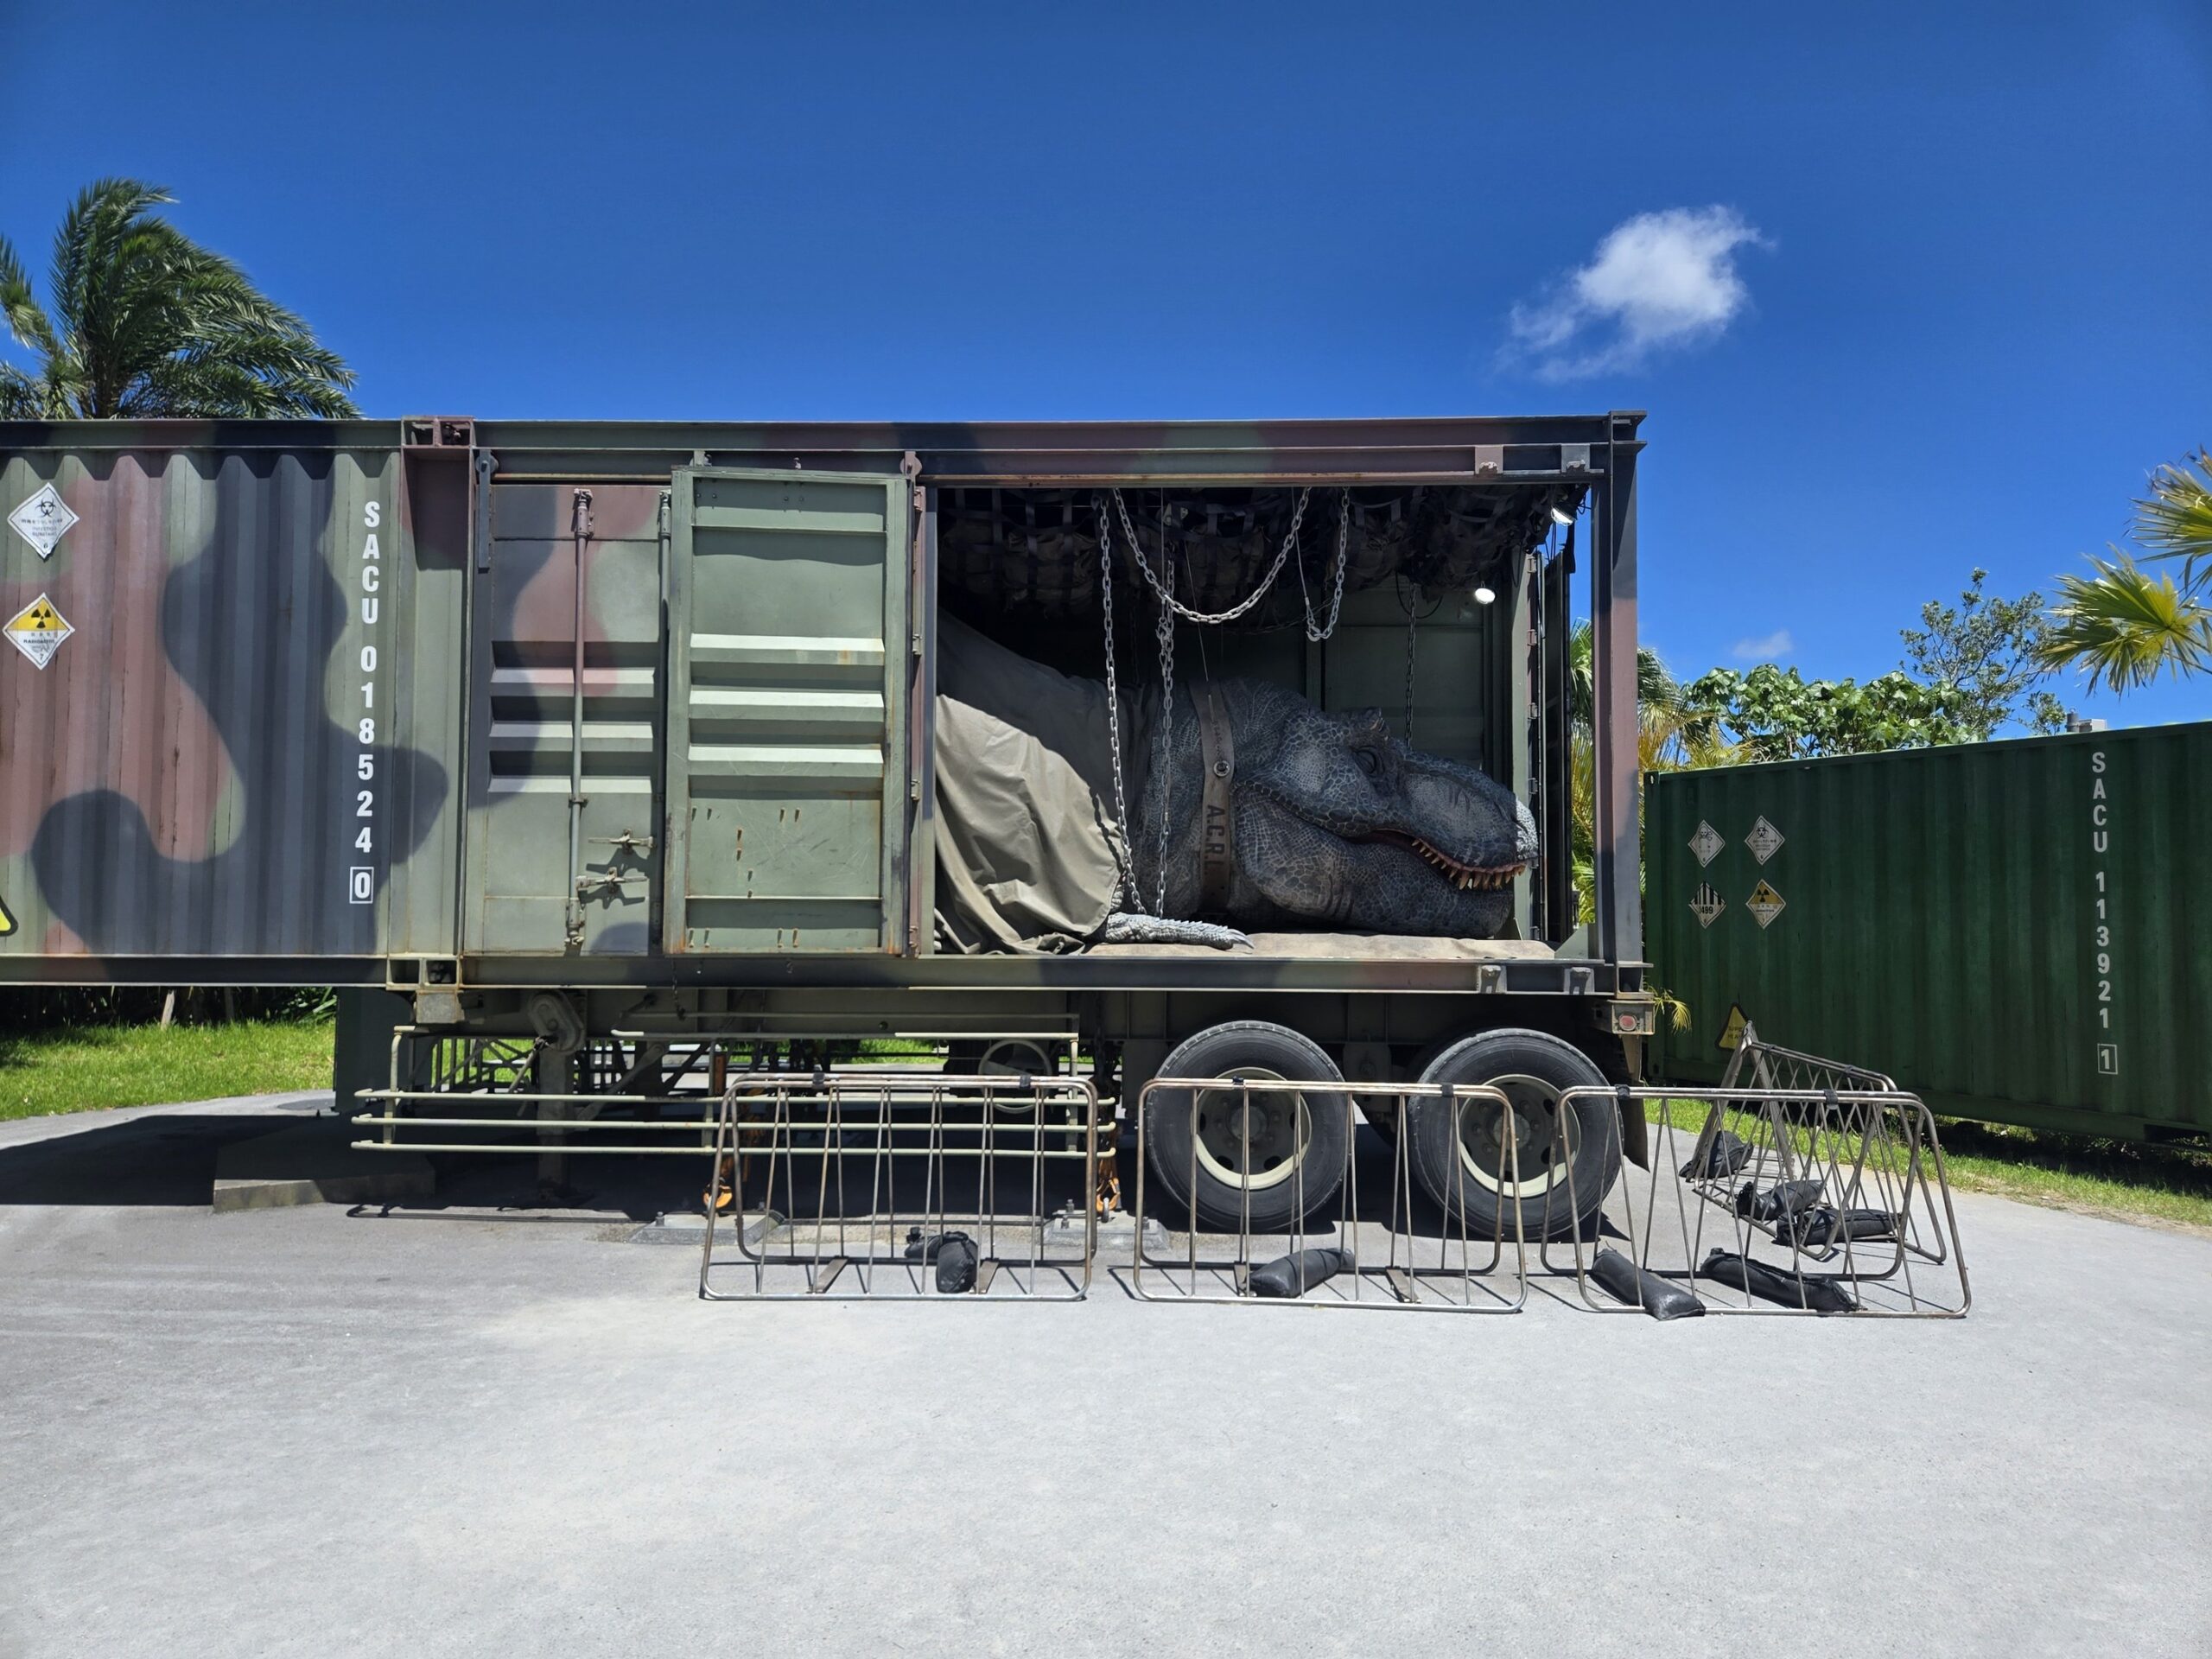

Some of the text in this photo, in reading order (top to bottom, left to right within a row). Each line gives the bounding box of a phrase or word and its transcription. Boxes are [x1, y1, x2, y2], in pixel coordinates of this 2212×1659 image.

[353, 500, 381, 900] SACU 018524 0
[2091, 752, 2108, 853] SACU
[2094, 871, 2112, 1028] 113921
